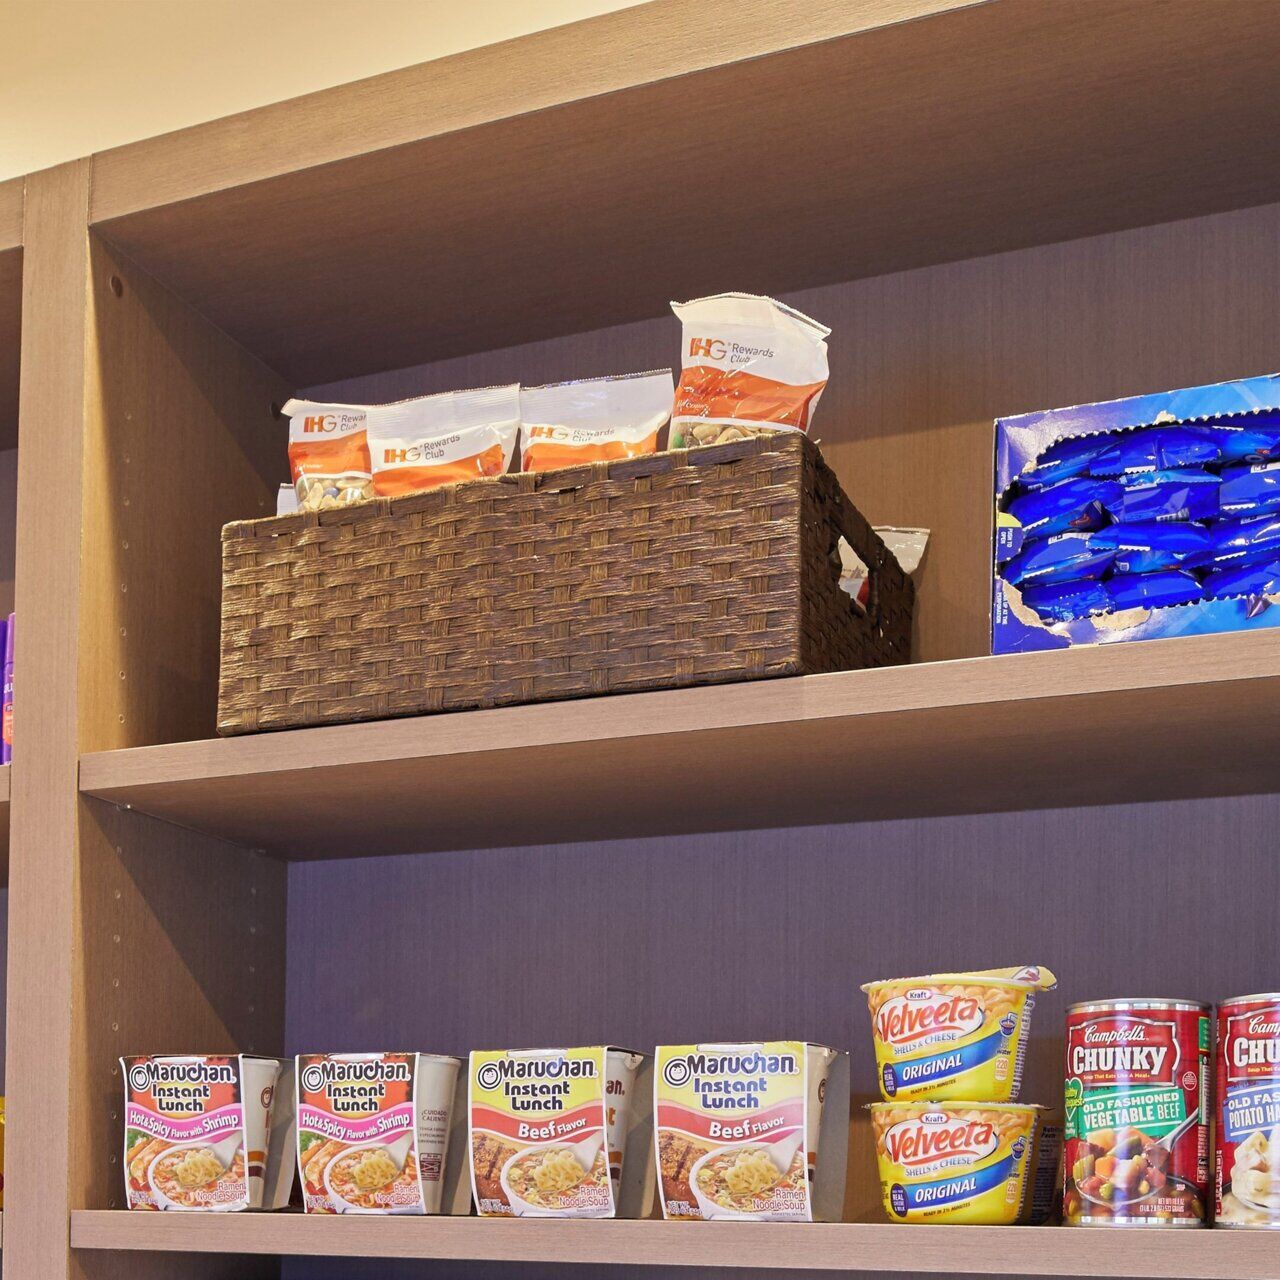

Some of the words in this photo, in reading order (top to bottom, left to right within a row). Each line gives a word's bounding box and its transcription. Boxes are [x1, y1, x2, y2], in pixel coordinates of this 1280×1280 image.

[690, 338, 726, 360] IHG
[732, 343, 774, 358] Rewards
[730, 354, 750, 363] Club
[304, 416, 336, 432] IHG
[341, 414, 367, 423] Rewar
[341, 423, 357, 431] Club
[529, 427, 568, 439] IHG
[384, 447, 420, 463] IHG
[424, 434, 460, 451] Rewards
[425, 449, 444, 460] Club
[909, 991, 927, 999] Kraft
[881, 996, 978, 1042] Velveeta
[894, 1043, 917, 1055] SHELLS
[918, 1040, 923, 1048] &
[925, 1032, 957, 1046] CHEESE
[1085, 1025, 1145, 1044] Campbell's
[499, 1058, 594, 1079] Maruchan
[687, 1053, 794, 1076] Maruchan
[903, 1054, 962, 1081] ORIGINAL
[1073, 1046, 1167, 1075] CHUNKY
[146, 1062, 233, 1083] Maruchan
[321, 1062, 408, 1082] Maruchan
[152, 1083, 210, 1098] Instant
[327, 1083, 385, 1098] Instant
[504, 1081, 570, 1096] Instant
[694, 1078, 767, 1093] Instant
[158, 1098, 203, 1112] Lunch
[333, 1098, 378, 1112] Lunch
[511, 1097, 562, 1111] Lunch
[702, 1093, 759, 1109] Lunch
[1083, 1100, 1105, 1112] OLD
[1107, 1092, 1179, 1110] FASHIONED
[1228, 1097, 1252, 1110] OLD
[925, 1115, 944, 1123] Kraft
[1084, 1107, 1155, 1129] VEGETABLE
[1158, 1099, 1180, 1119] BEEF
[1229, 1111, 1264, 1130] POTATO
[130, 1110, 171, 1138] Hot&Spicy
[171, 1127, 189, 1139] Flavor
[204, 1114, 238, 1132] Shrimp
[302, 1112, 346, 1141] Hot&Spicy
[347, 1127, 364, 1139] Flavor
[378, 1112, 410, 1132] Shrimp
[518, 1122, 556, 1140] Beef
[558, 1117, 587, 1134] Flavor
[709, 1120, 750, 1139] Beef
[752, 1116, 785, 1134] Flavor
[890, 1120, 993, 1163] Velveeta
[905, 1165, 930, 1176] SHELLS
[940, 1157, 971, 1168] CHEESE
[580, 1188, 608, 1197] Ramen
[775, 1189, 804, 1199] Ramen
[915, 1178, 976, 1203] ORIGINAL
[560, 1197, 587, 1207] Noodle
[588, 1196, 609, 1208] Soup
[753, 1199, 782, 1209] Noodle
[783, 1199, 805, 1211] Soup
